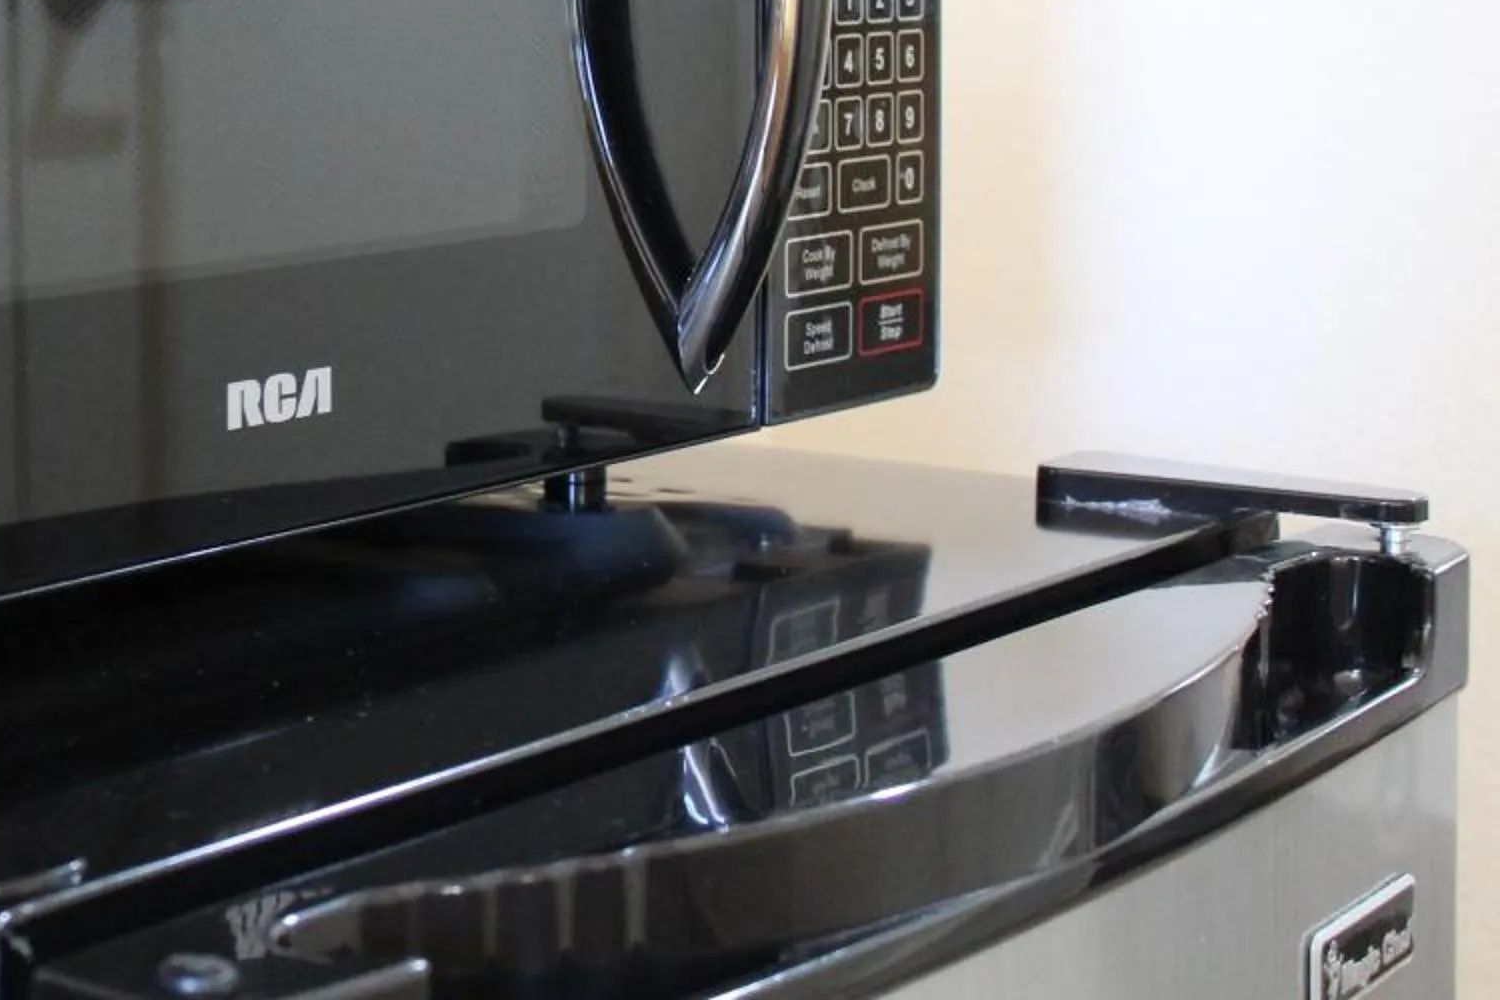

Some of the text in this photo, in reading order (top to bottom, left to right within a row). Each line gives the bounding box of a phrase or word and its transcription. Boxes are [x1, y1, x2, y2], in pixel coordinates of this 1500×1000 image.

[843, 49, 854, 73] 4
[875, 47, 885, 70] 5
[905, 45, 916, 68] 6
[843, 112, 854, 136] 7
[875, 109, 885, 133] 8
[905, 105, 915, 129] 9
[904, 167, 915, 191] 0
[227, 366, 332, 431] RCA
